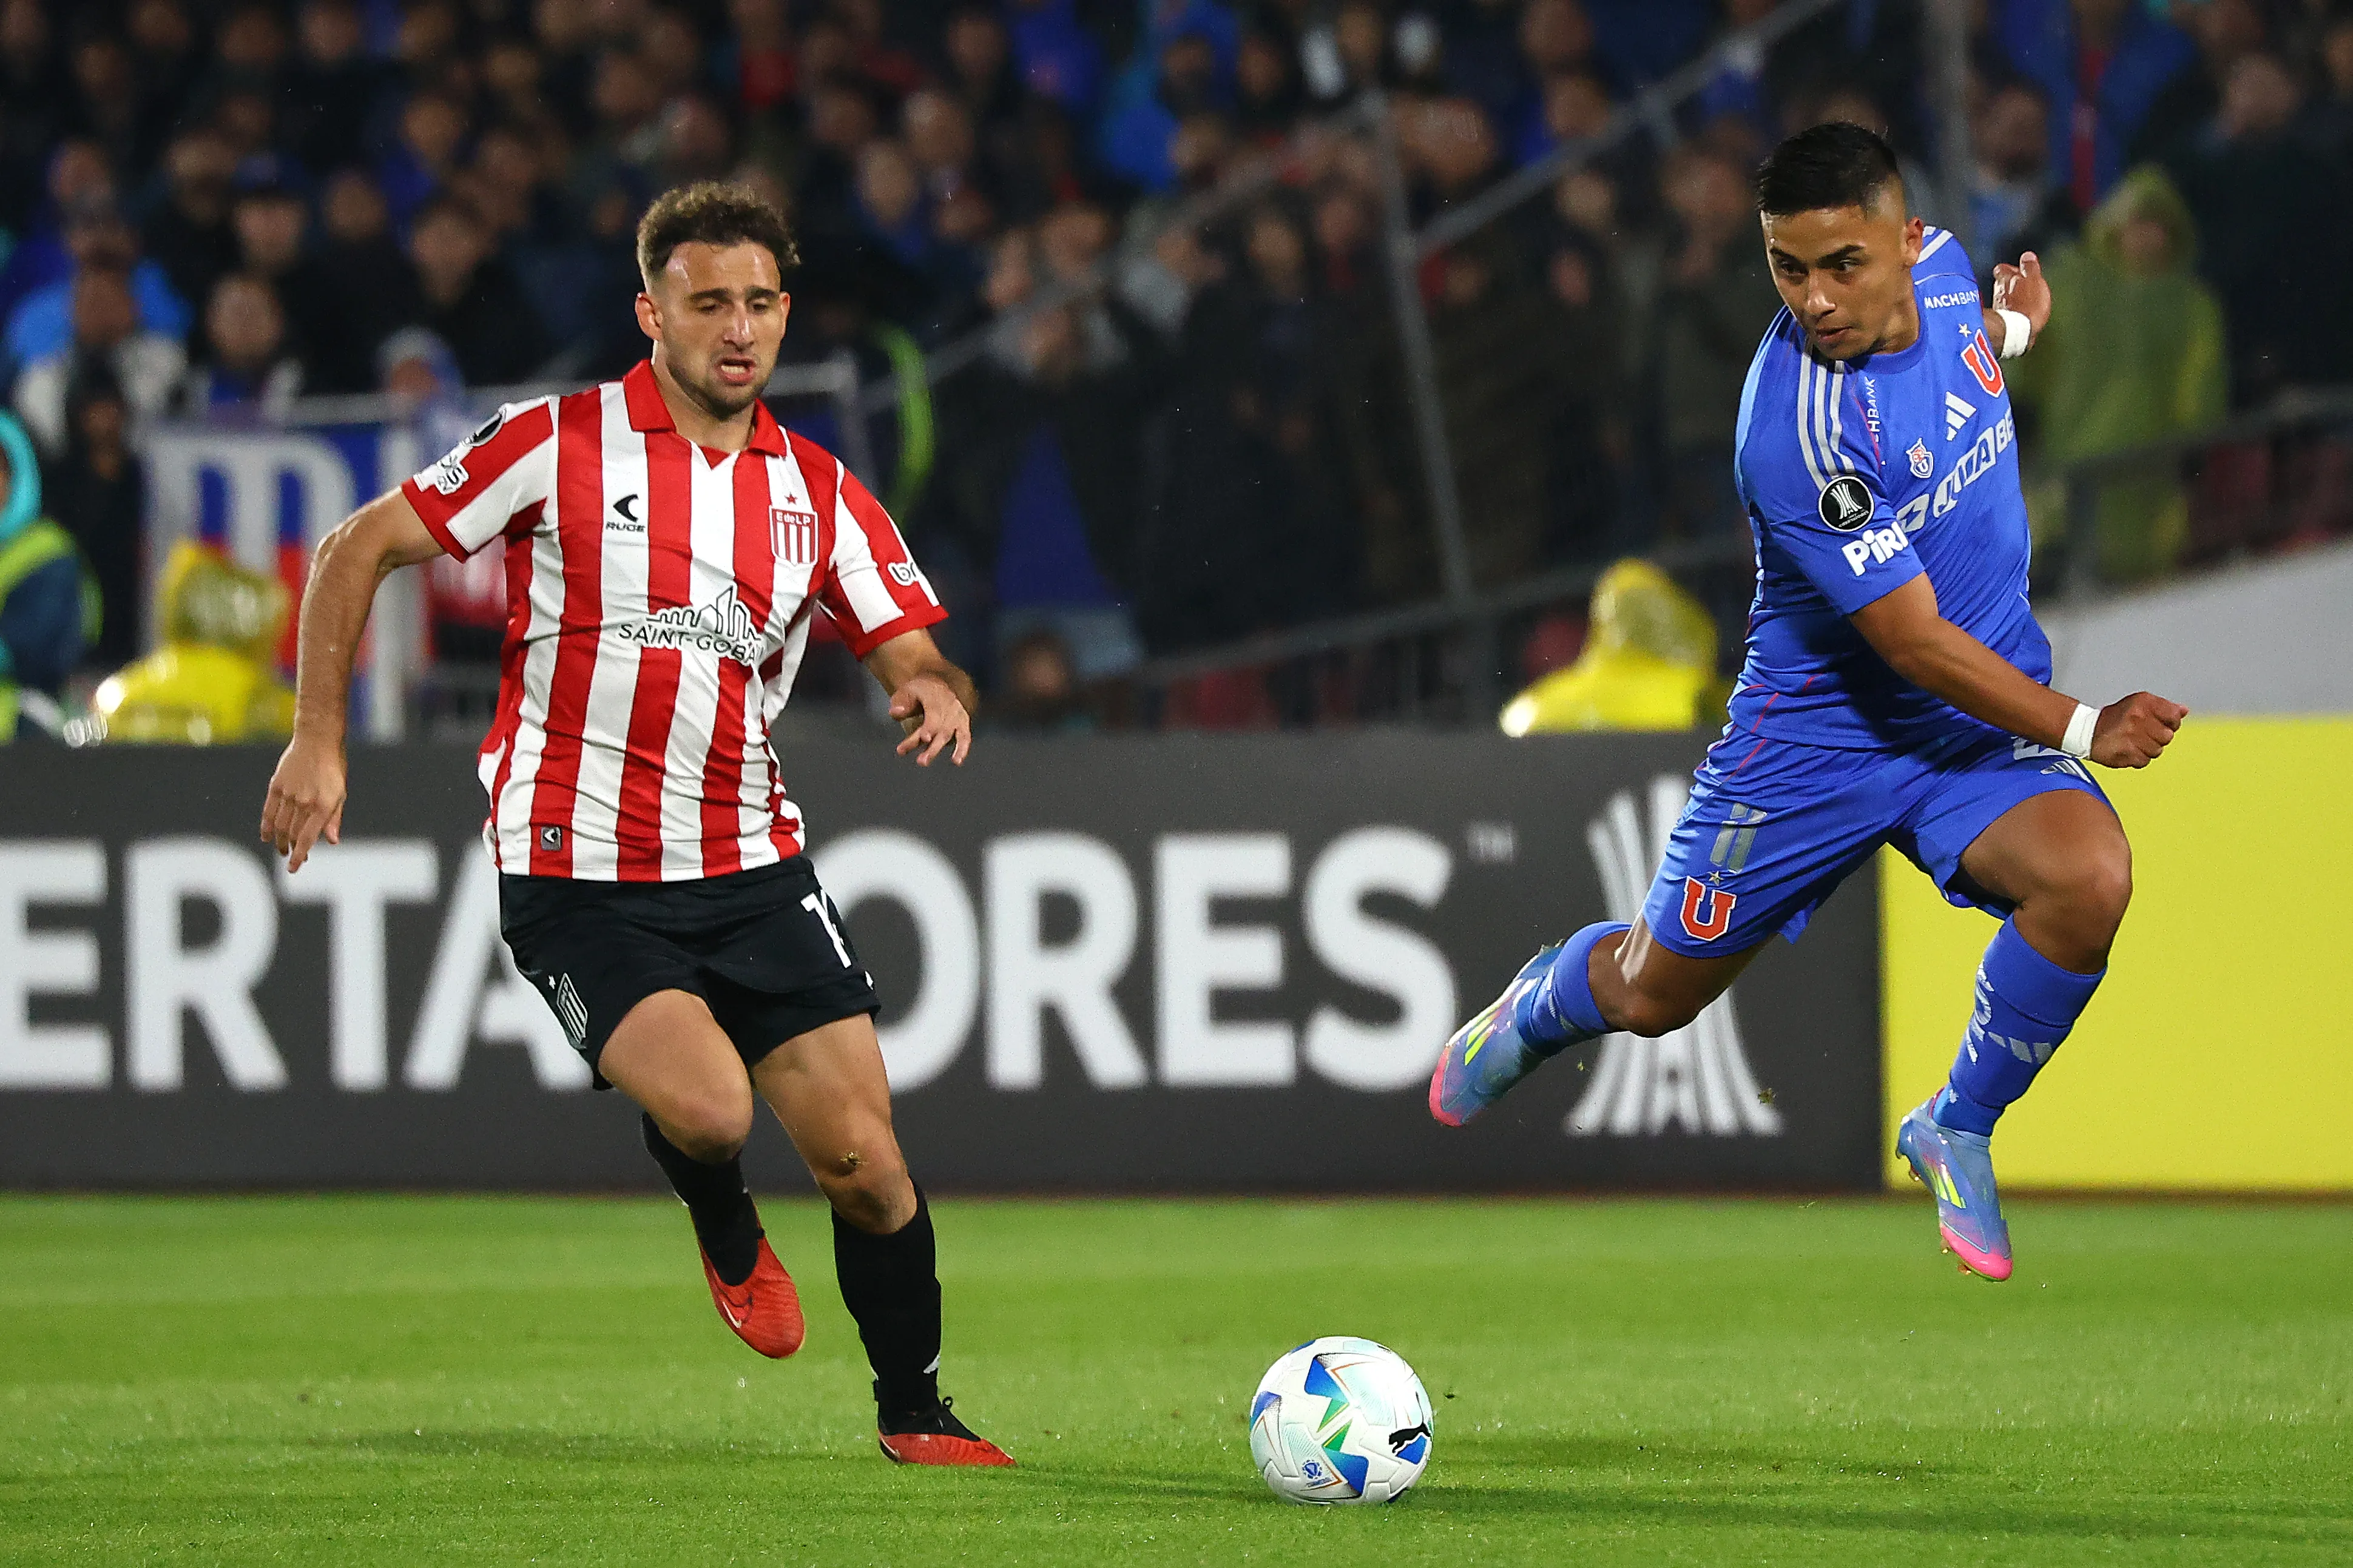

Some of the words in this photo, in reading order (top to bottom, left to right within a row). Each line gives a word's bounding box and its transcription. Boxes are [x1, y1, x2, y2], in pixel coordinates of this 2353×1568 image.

[1960, 328, 2005, 399] U
[1680, 876, 1738, 941] U
[0, 826, 1459, 1097] ERTAORES
